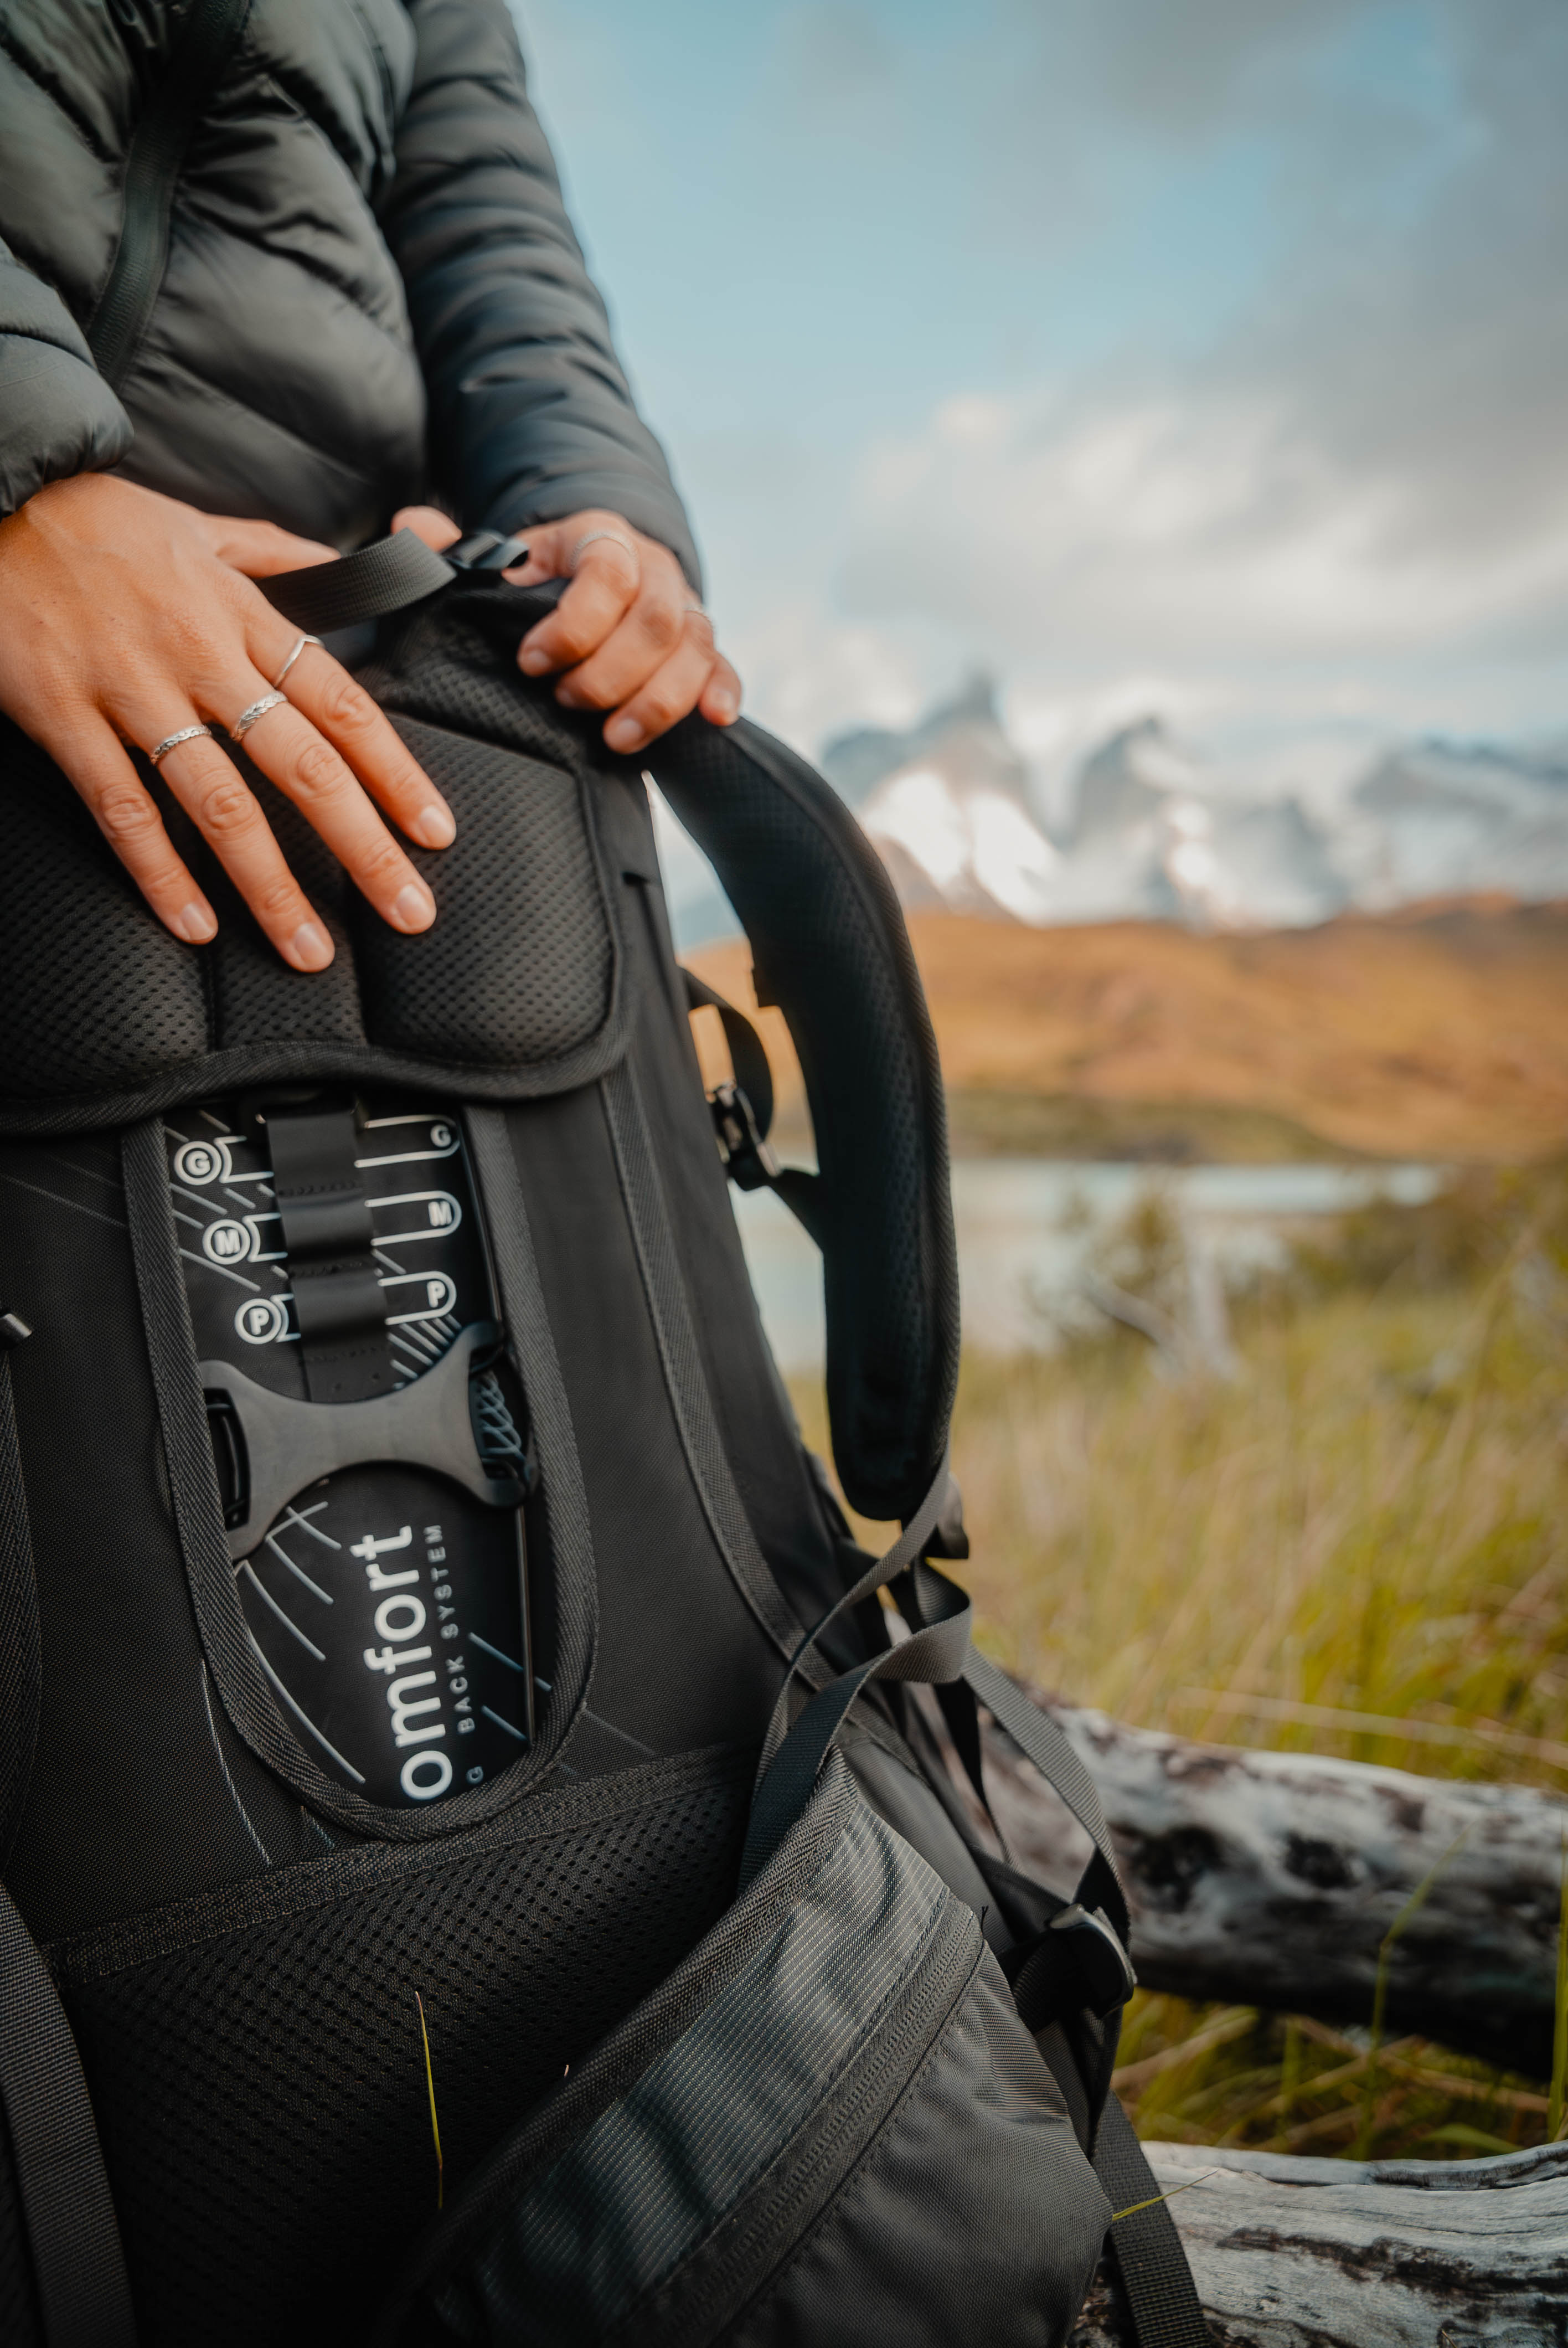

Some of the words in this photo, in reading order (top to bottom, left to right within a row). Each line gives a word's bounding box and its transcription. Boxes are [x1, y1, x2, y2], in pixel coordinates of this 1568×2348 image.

[430, 1124, 451, 1147] G
[186, 1150, 210, 1176] G
[428, 1201, 452, 1227] M
[214, 1229, 241, 1255] M
[427, 1280, 446, 1307] P
[249, 1307, 270, 1335] P
[424, 1525, 459, 1639] SYSTEM
[350, 1525, 453, 1800] omfort
[446, 1655, 475, 1734] BACK
